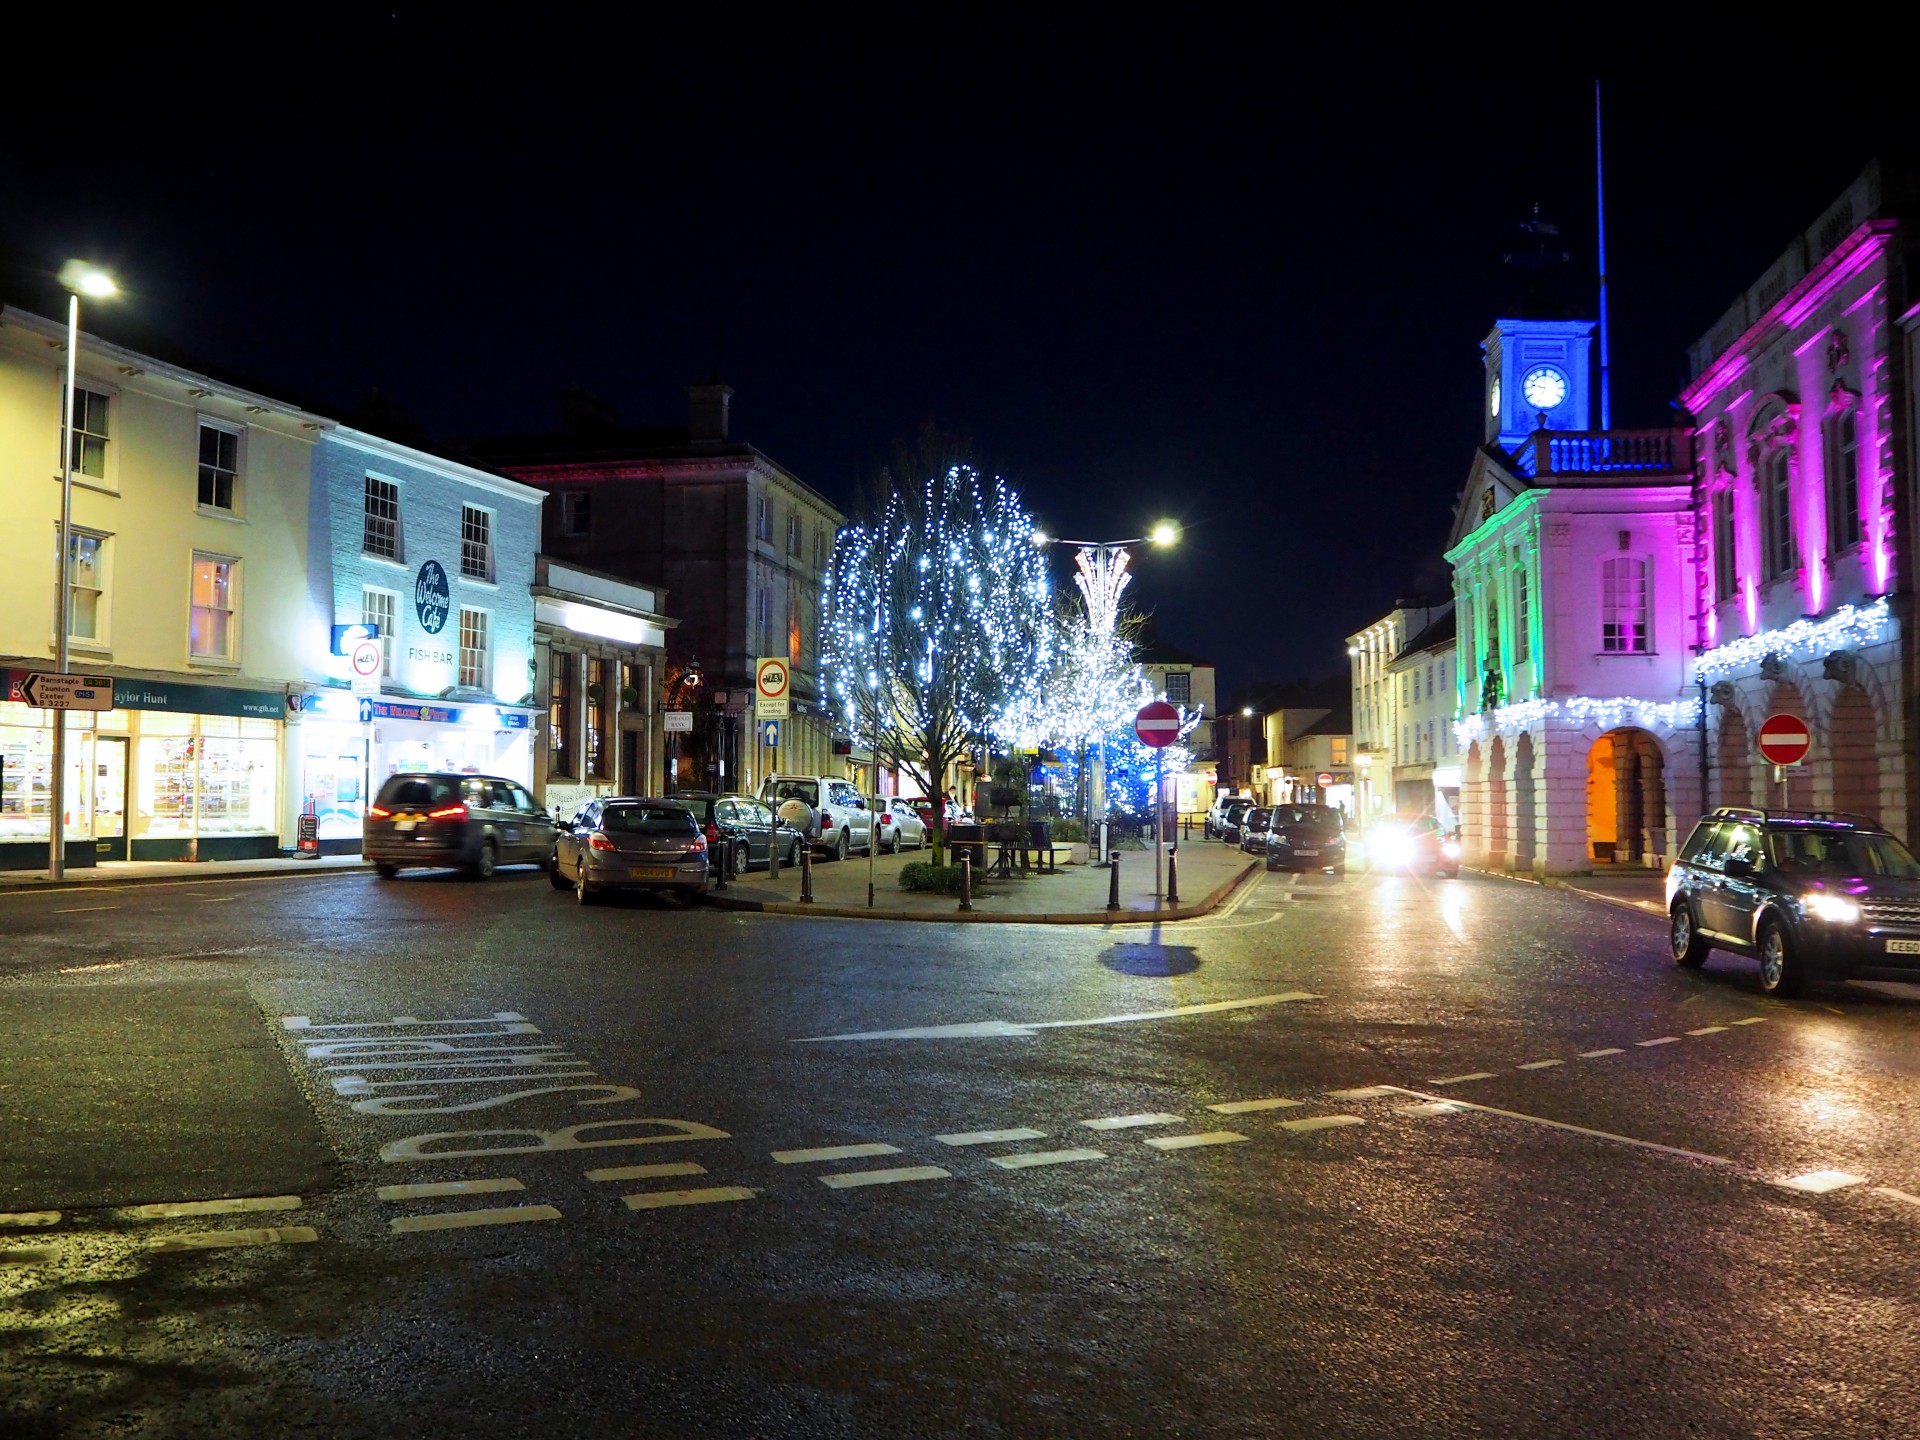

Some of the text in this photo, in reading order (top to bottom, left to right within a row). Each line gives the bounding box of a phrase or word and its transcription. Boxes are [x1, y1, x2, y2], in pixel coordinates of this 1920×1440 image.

[425, 563, 440, 585] The
[416, 580, 449, 609] Welcome
[409, 648, 453, 665] FISH BAR
[40, 676, 80, 685] Barnstaple
[113, 690, 167, 704] aylor Hunt
[243, 704, 279, 713] www.gth.net
